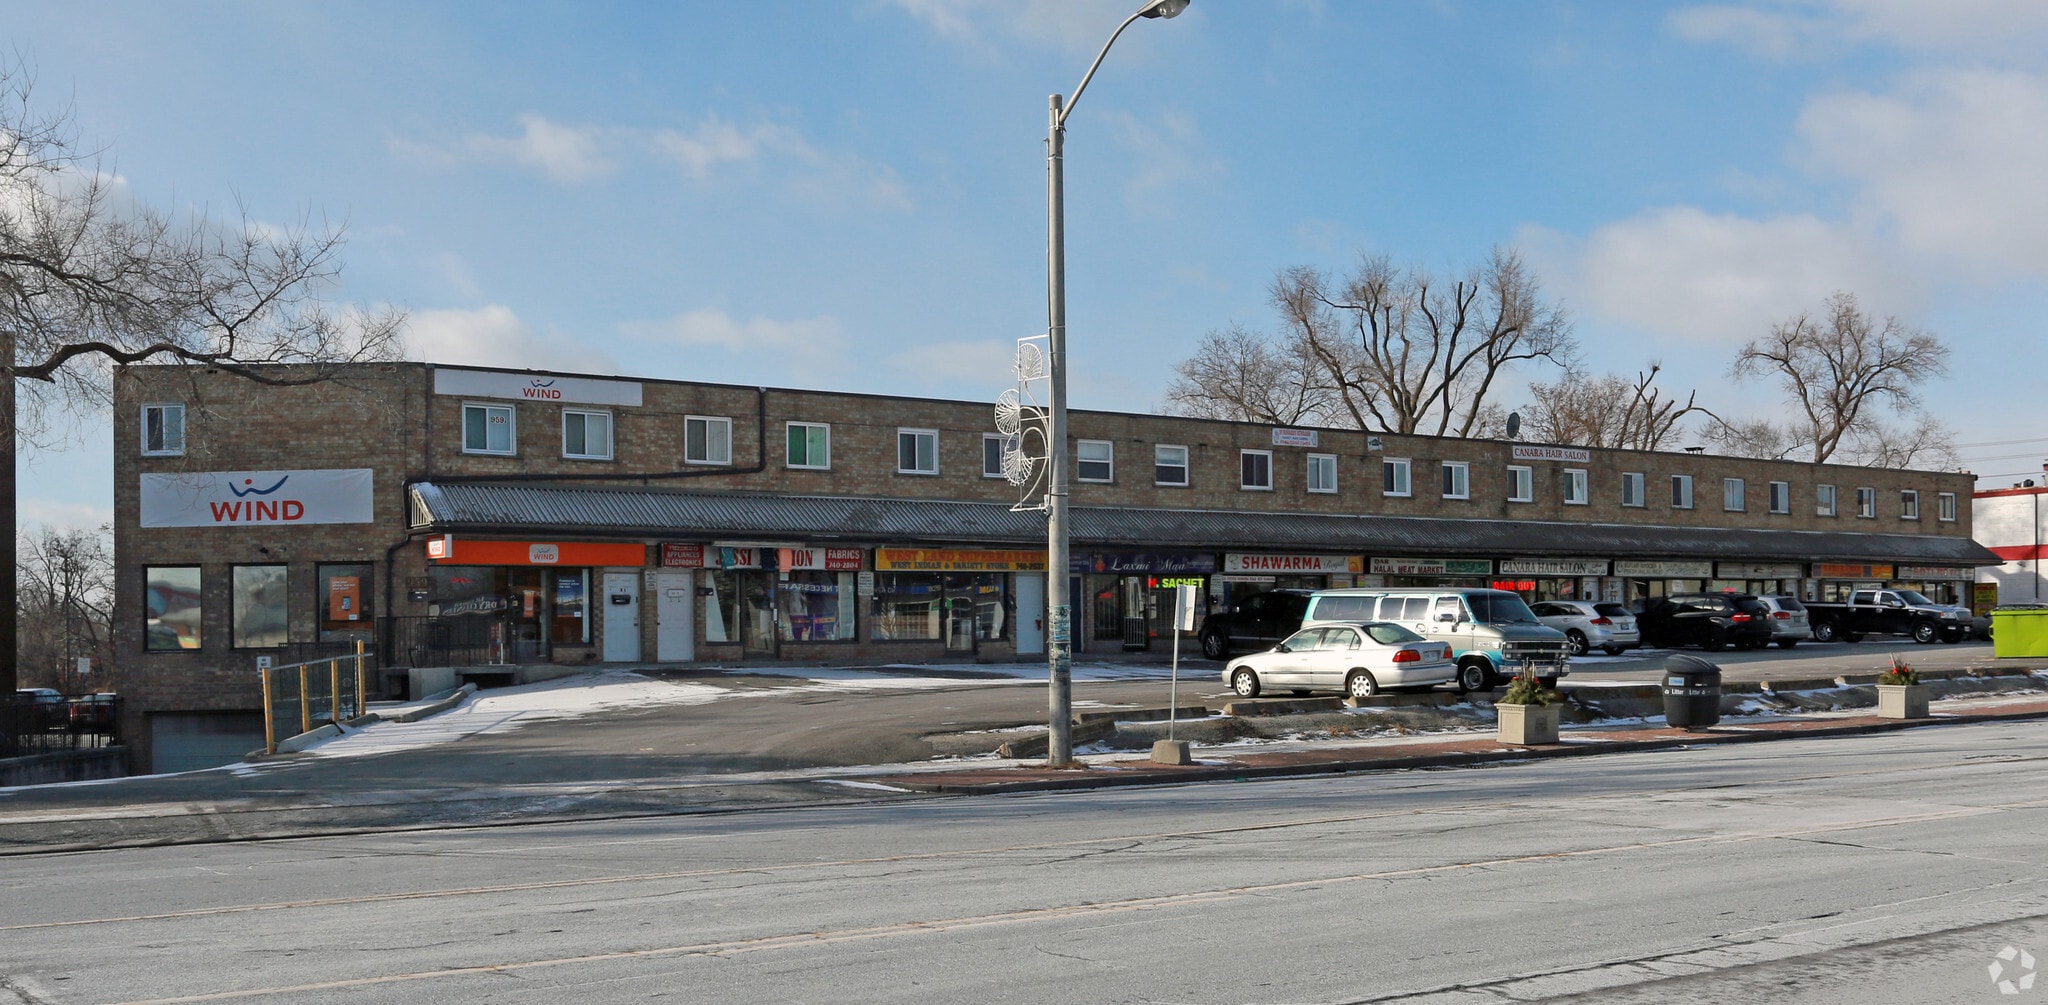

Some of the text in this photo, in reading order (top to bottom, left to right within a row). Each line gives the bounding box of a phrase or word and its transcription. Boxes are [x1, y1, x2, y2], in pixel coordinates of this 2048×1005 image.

[523, 388, 561, 399] WIND
[1514, 448, 1587, 460] CANARA HAIR SALON
[209, 500, 305, 522] WIND
[533, 553, 554, 561] WIND
[666, 551, 701, 559] APPLIANCES
[828, 549, 861, 560] FABRICS
[884, 551, 1044, 564] WEST LAND SUPERMARKET
[953, 562, 983, 570] VARIETY
[986, 562, 1009, 570] STORE
[1111, 557, 1151, 571] Laxmi
[1242, 556, 1322, 570] SHAWARMA
[1502, 561, 1536, 573] CANARA
[1538, 561, 1560, 573] HAIR
[1560, 562, 1587, 574] SALON
[1374, 565, 1395, 573] HALAL
[1398, 566, 1416, 574] MEAT
[1418, 566, 1444, 575] MARKET
